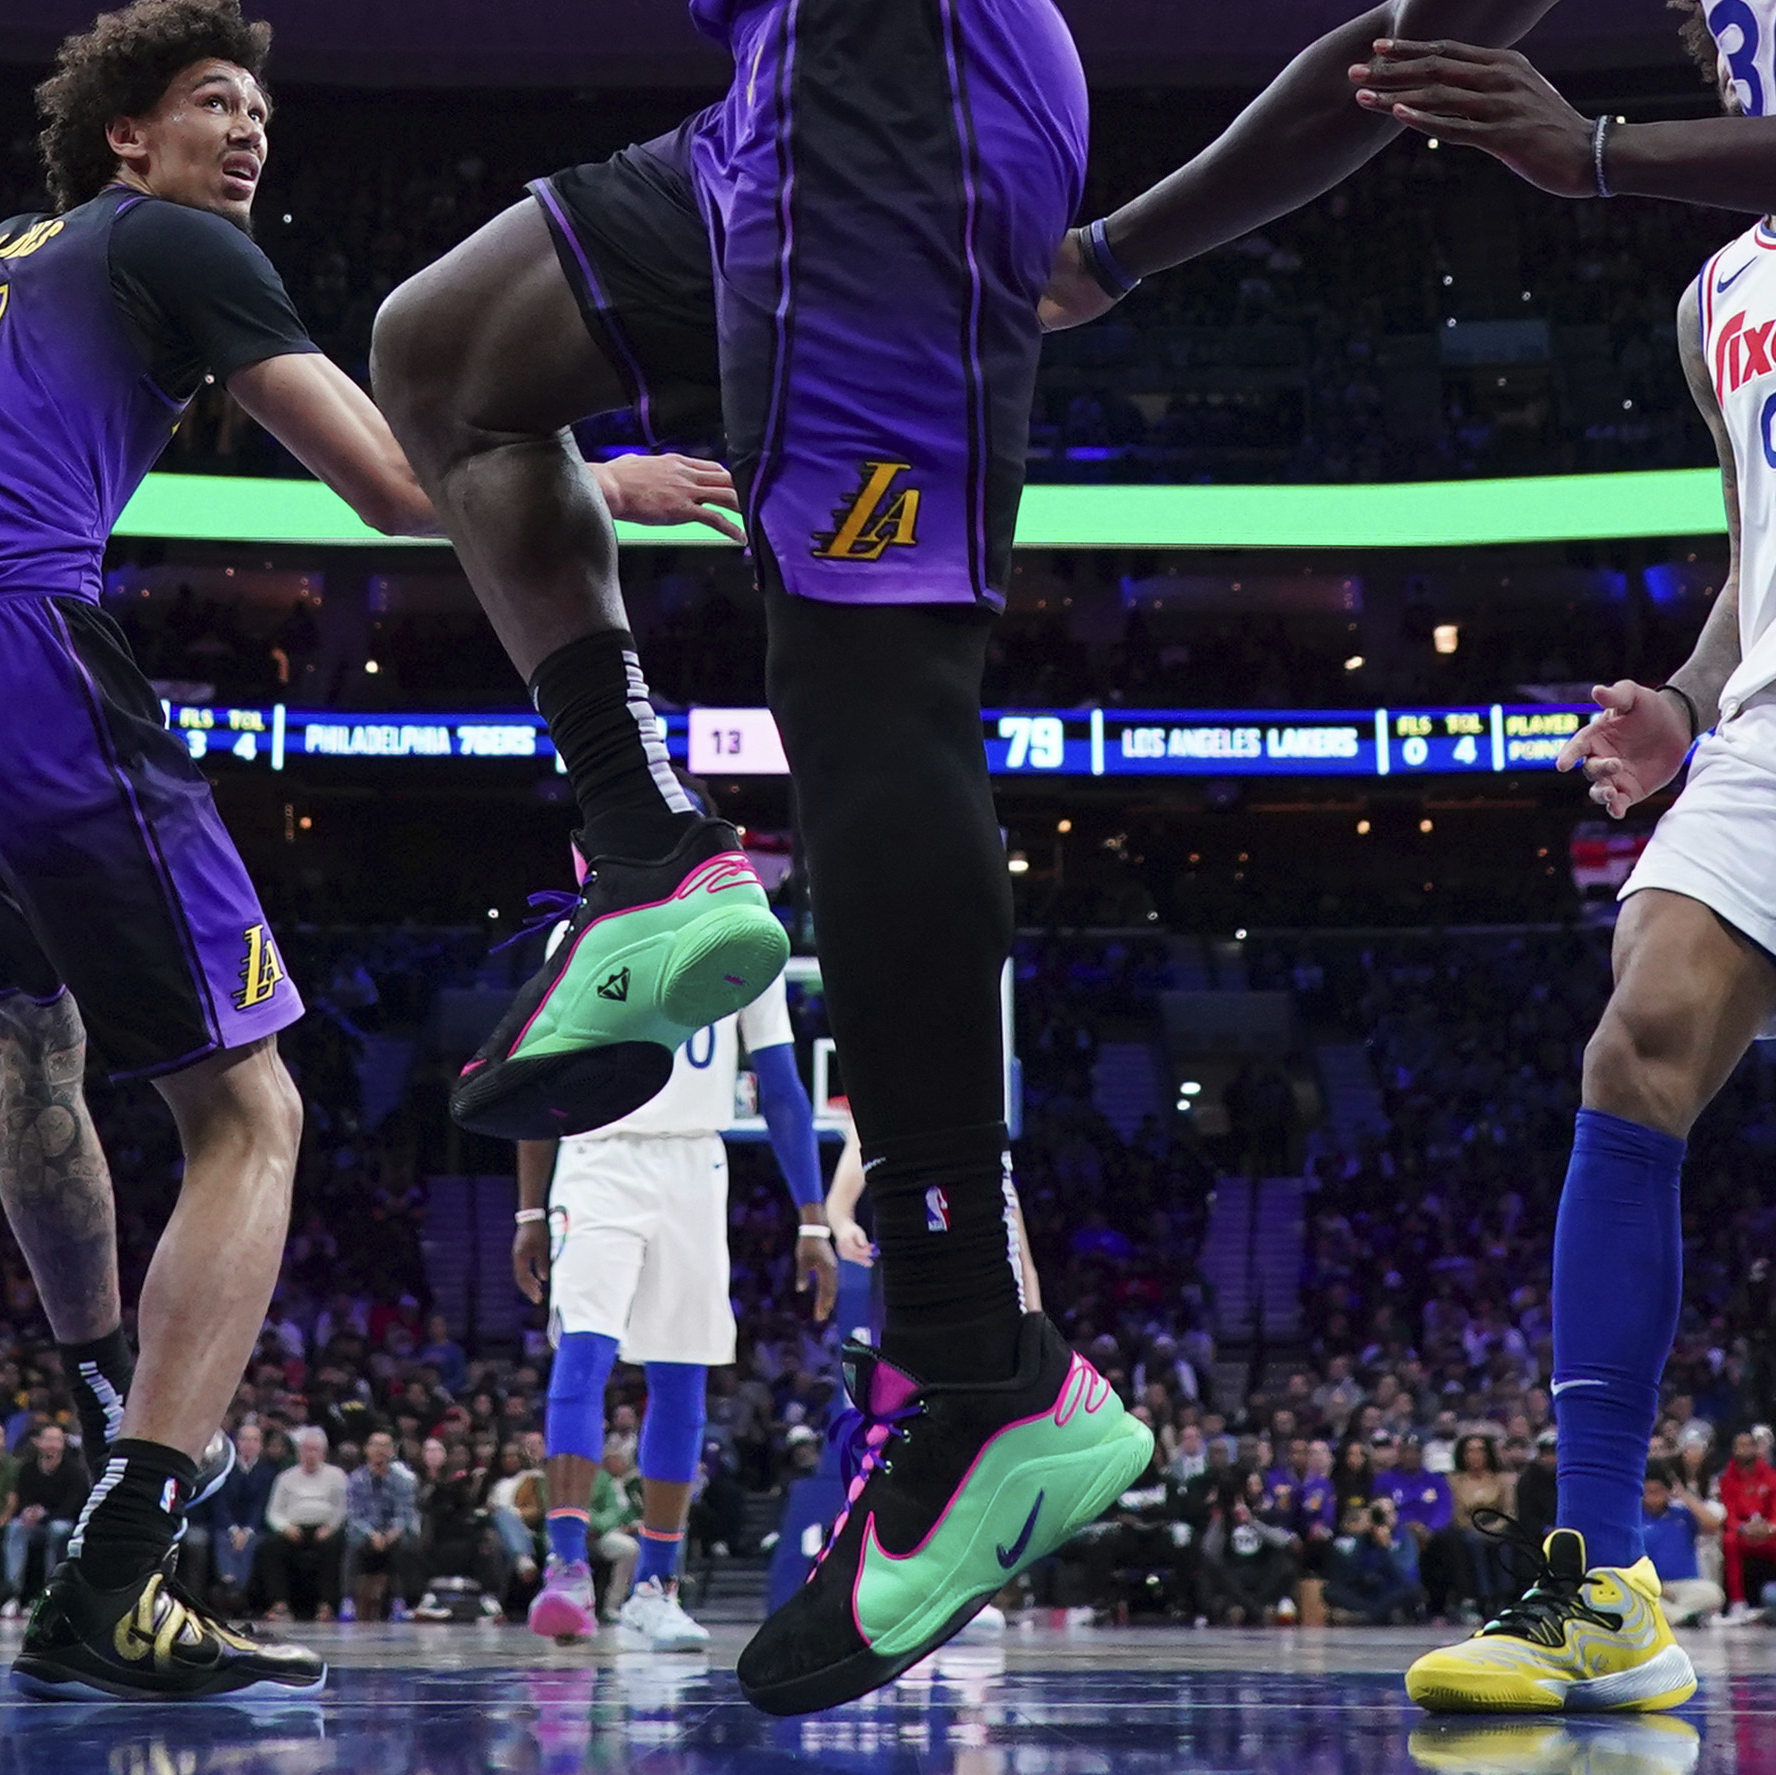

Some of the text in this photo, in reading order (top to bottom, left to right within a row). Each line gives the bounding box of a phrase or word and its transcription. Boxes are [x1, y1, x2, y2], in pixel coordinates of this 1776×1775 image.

[179, 707, 215, 730] FLS
[1396, 714, 1432, 737] FLS
[1505, 714, 1579, 736] PLAYER
[186, 730, 258, 761] 3 4
[304, 723, 537, 757] PHILADELPHIA 76ERS
[711, 729, 741, 756] 13
[998, 715, 1064, 769] 79
[1121, 726, 1359, 759] LOS ANGELES LAKERS
[1402, 734, 1477, 767] 0 4
